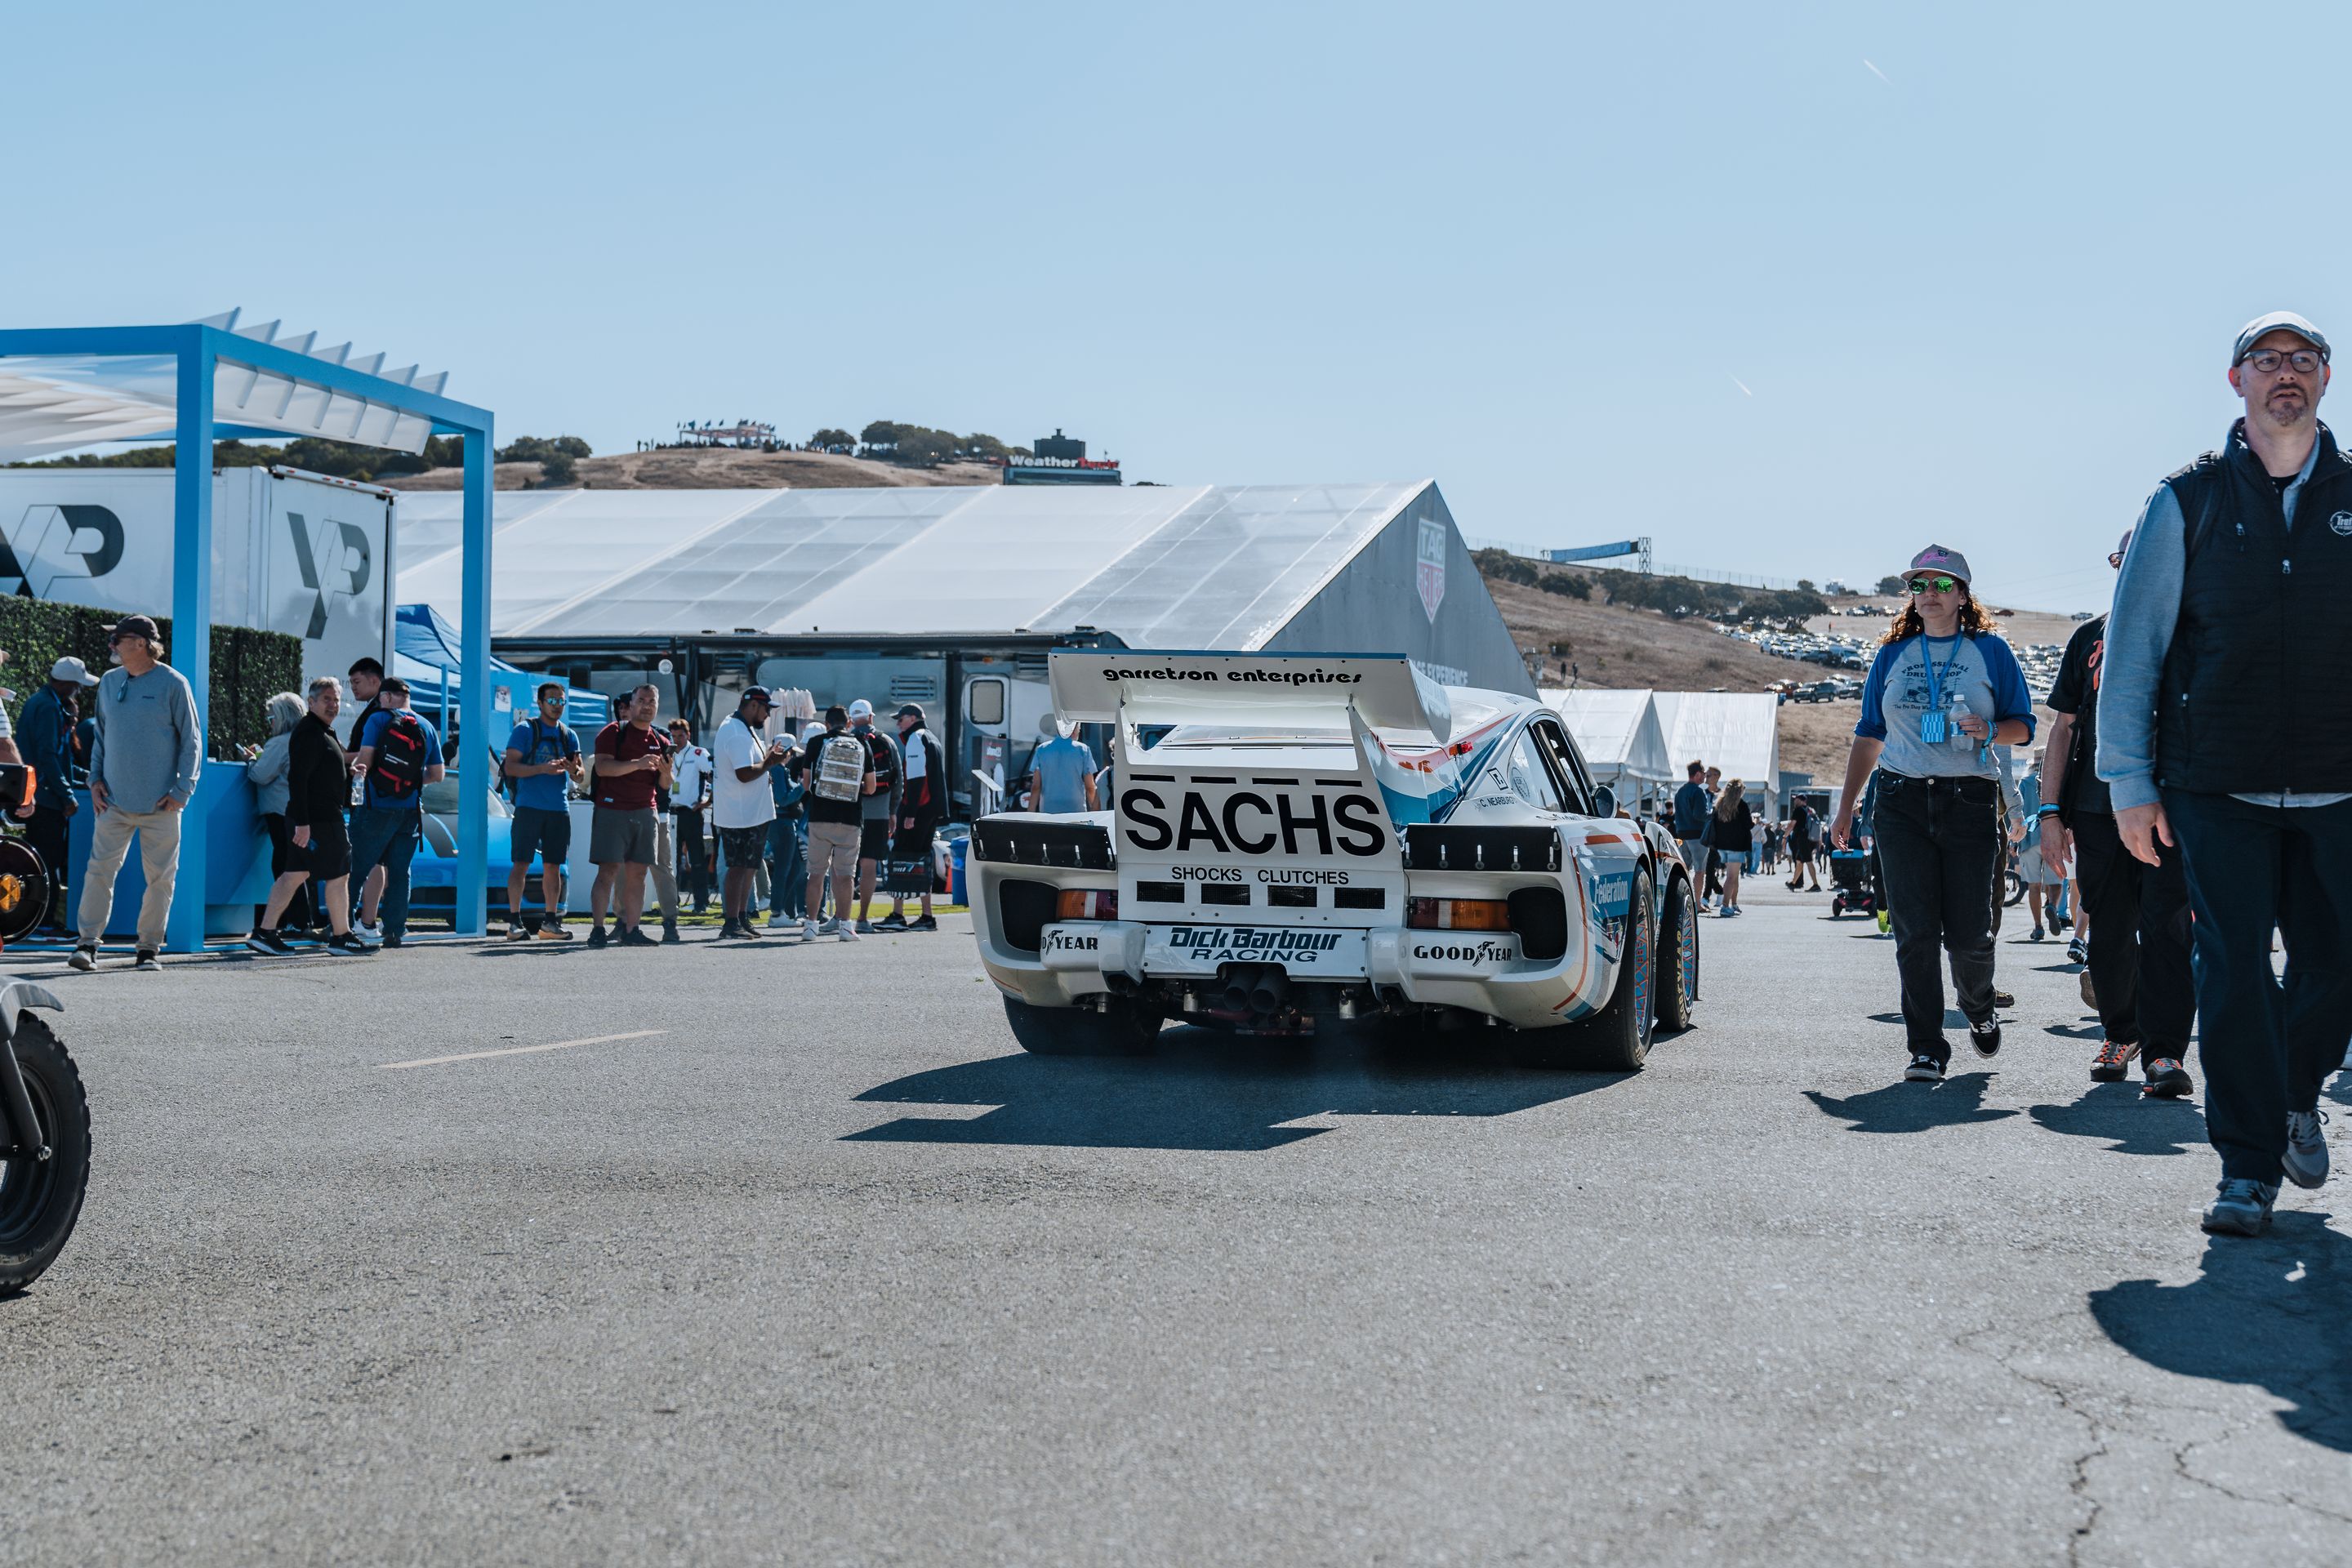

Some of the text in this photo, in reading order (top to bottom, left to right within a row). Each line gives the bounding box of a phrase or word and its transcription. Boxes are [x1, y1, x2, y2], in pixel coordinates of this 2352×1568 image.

[1009, 454, 1120, 469] WeatherTech
[1420, 527, 1444, 563] TAG
[1102, 667, 1362, 686] garretson enterprises
[1427, 662, 1468, 687] EXPERIENCE
[1120, 788, 1386, 857] SACHS
[1171, 866, 1349, 884] SHOCKS CLUTCHES
[1594, 875, 1628, 904] Federation
[1169, 927, 1343, 951] Dick Barbour
[1190, 948, 1318, 963] RACING
